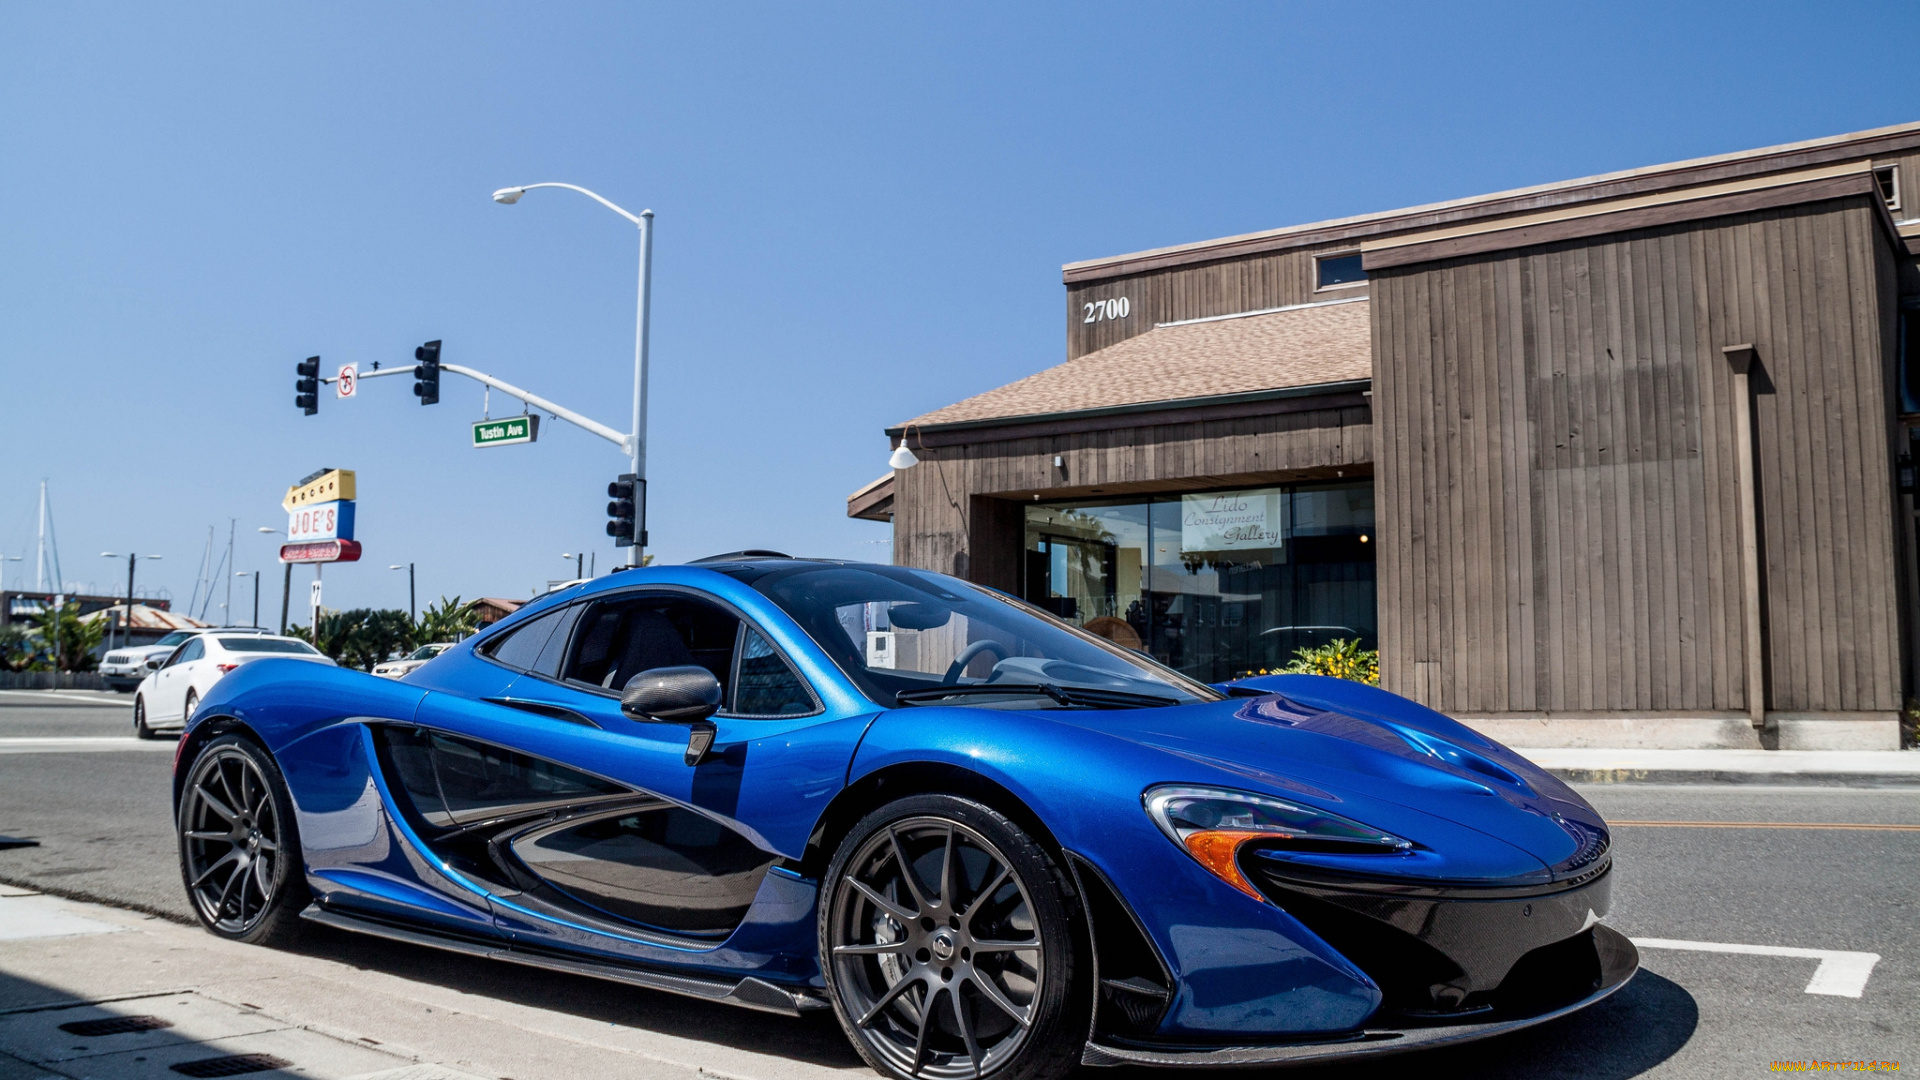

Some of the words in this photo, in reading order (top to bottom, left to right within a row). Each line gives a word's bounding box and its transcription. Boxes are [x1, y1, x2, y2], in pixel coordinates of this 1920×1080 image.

[1083, 296, 1130, 324] 2700
[479, 425, 505, 441] Tustin
[506, 423, 524, 437] Ave
[1204, 493, 1248, 514] Lido
[291, 508, 335, 535] JOE'S
[1184, 511, 1265, 530] Consignment
[1223, 523, 1279, 545] Gallery
